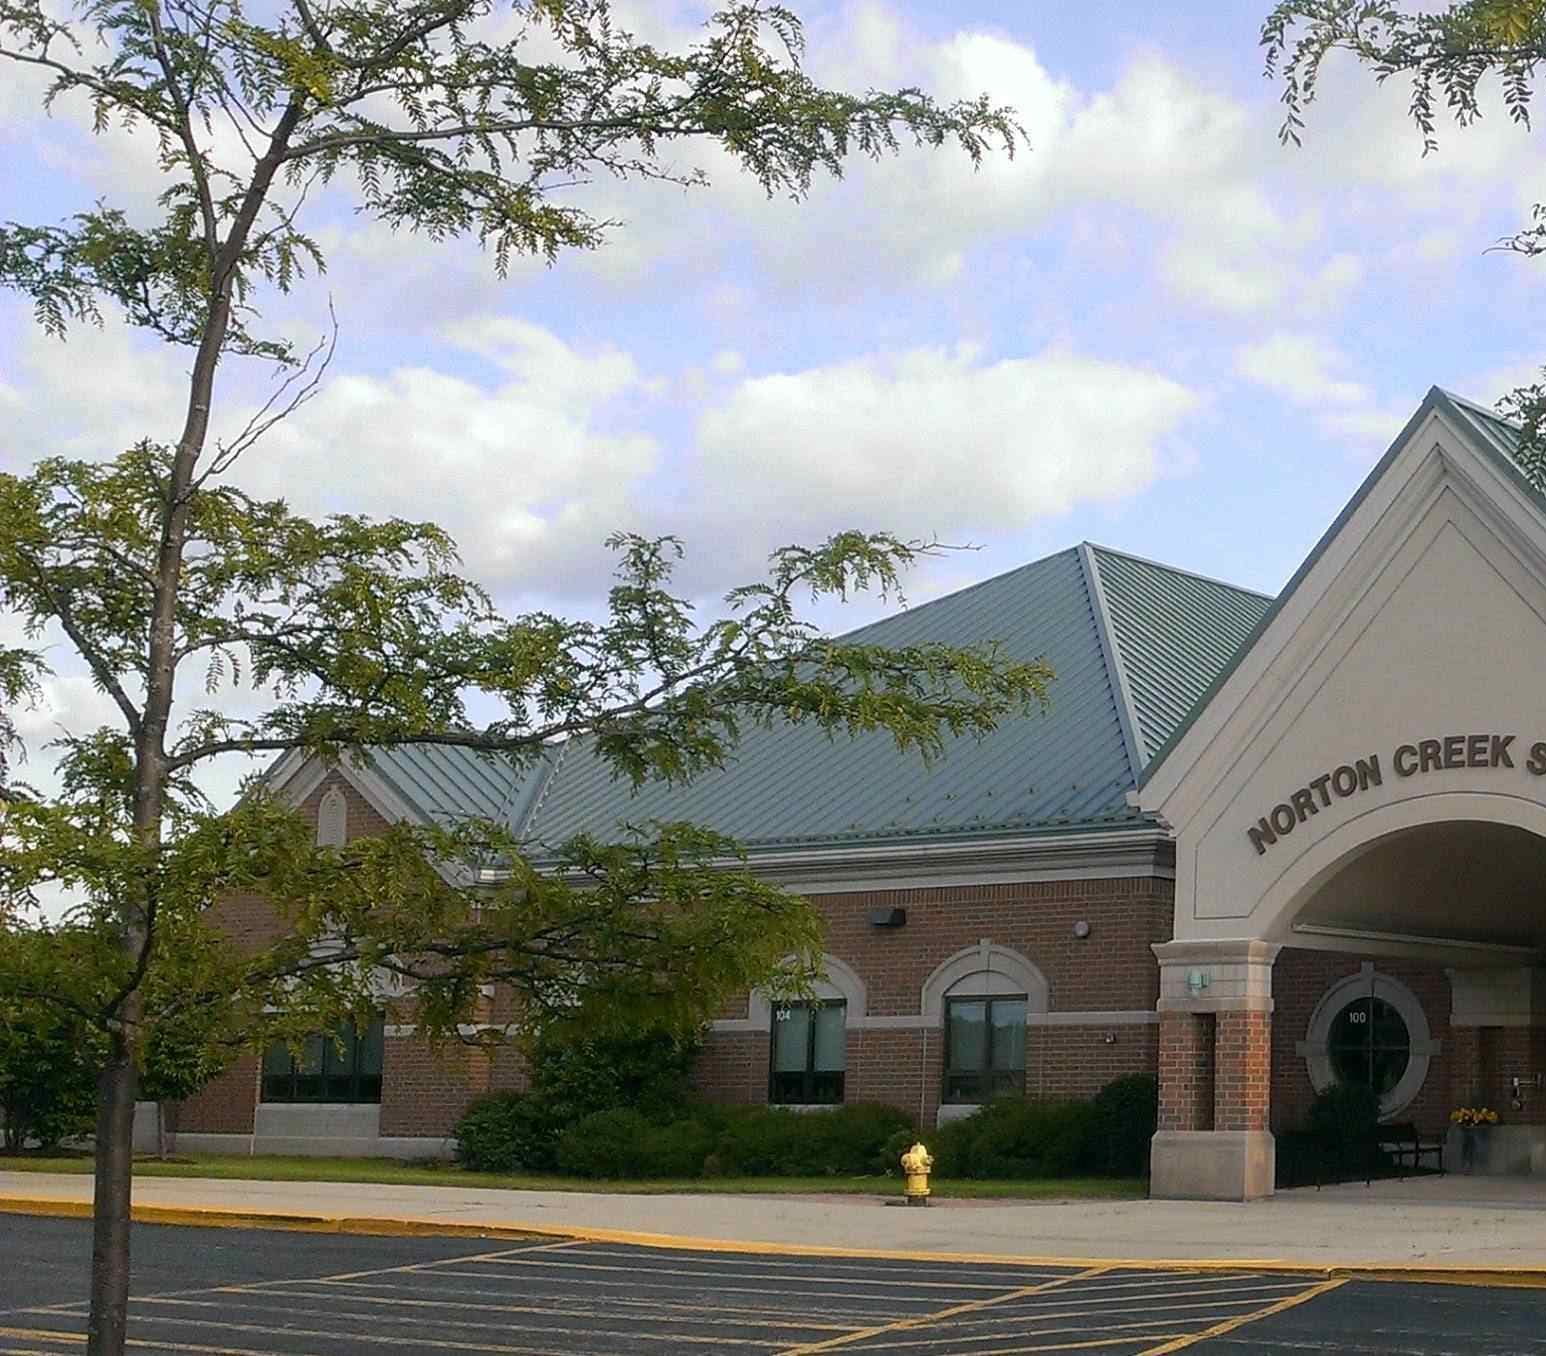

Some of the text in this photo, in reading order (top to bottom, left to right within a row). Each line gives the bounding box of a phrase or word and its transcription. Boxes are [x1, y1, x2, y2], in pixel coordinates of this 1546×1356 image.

[1247, 754, 1382, 855] NORTON
[1393, 735, 1517, 777] CREEK
[1349, 1012, 1367, 1023] 100
